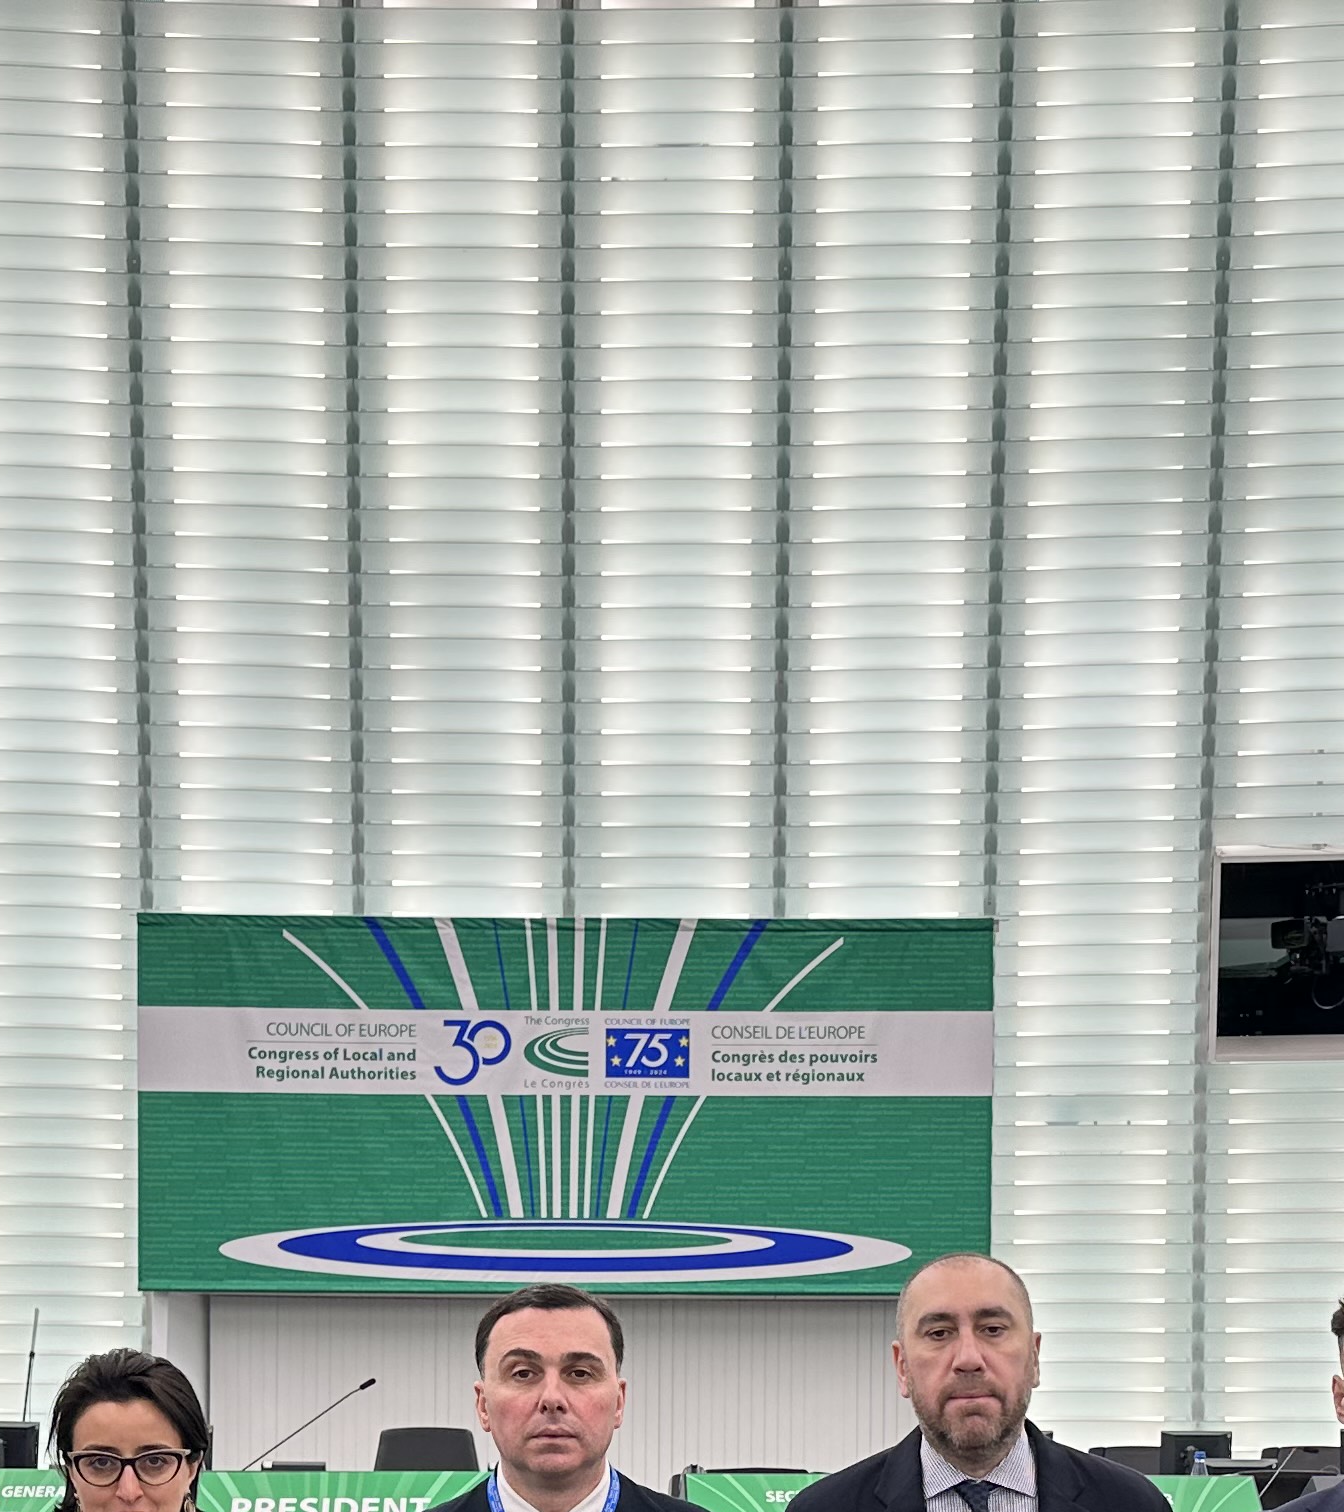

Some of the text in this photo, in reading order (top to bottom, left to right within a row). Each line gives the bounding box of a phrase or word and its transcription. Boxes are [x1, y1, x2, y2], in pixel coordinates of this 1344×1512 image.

[524, 1016, 590, 1027] The Congress
[604, 1017, 642, 1025] COUNCIL
[266, 1022, 417, 1038] COUNCIL OF EUROPE
[711, 1025, 866, 1040] CONSEIL DE L'EUROPE
[248, 1047, 417, 1063] Congress of Local and
[434, 1020, 512, 1086] 30
[623, 1033, 673, 1068] 75
[711, 1049, 878, 1066] Congrès des pouvoirs
[256, 1065, 417, 1082] Regional Authorities
[711, 1068, 865, 1085] locaux et régionaux
[524, 1079, 537, 1088] Le
[1, 1485, 67, 1498] GENERA
[765, 1490, 799, 1503] SEC
